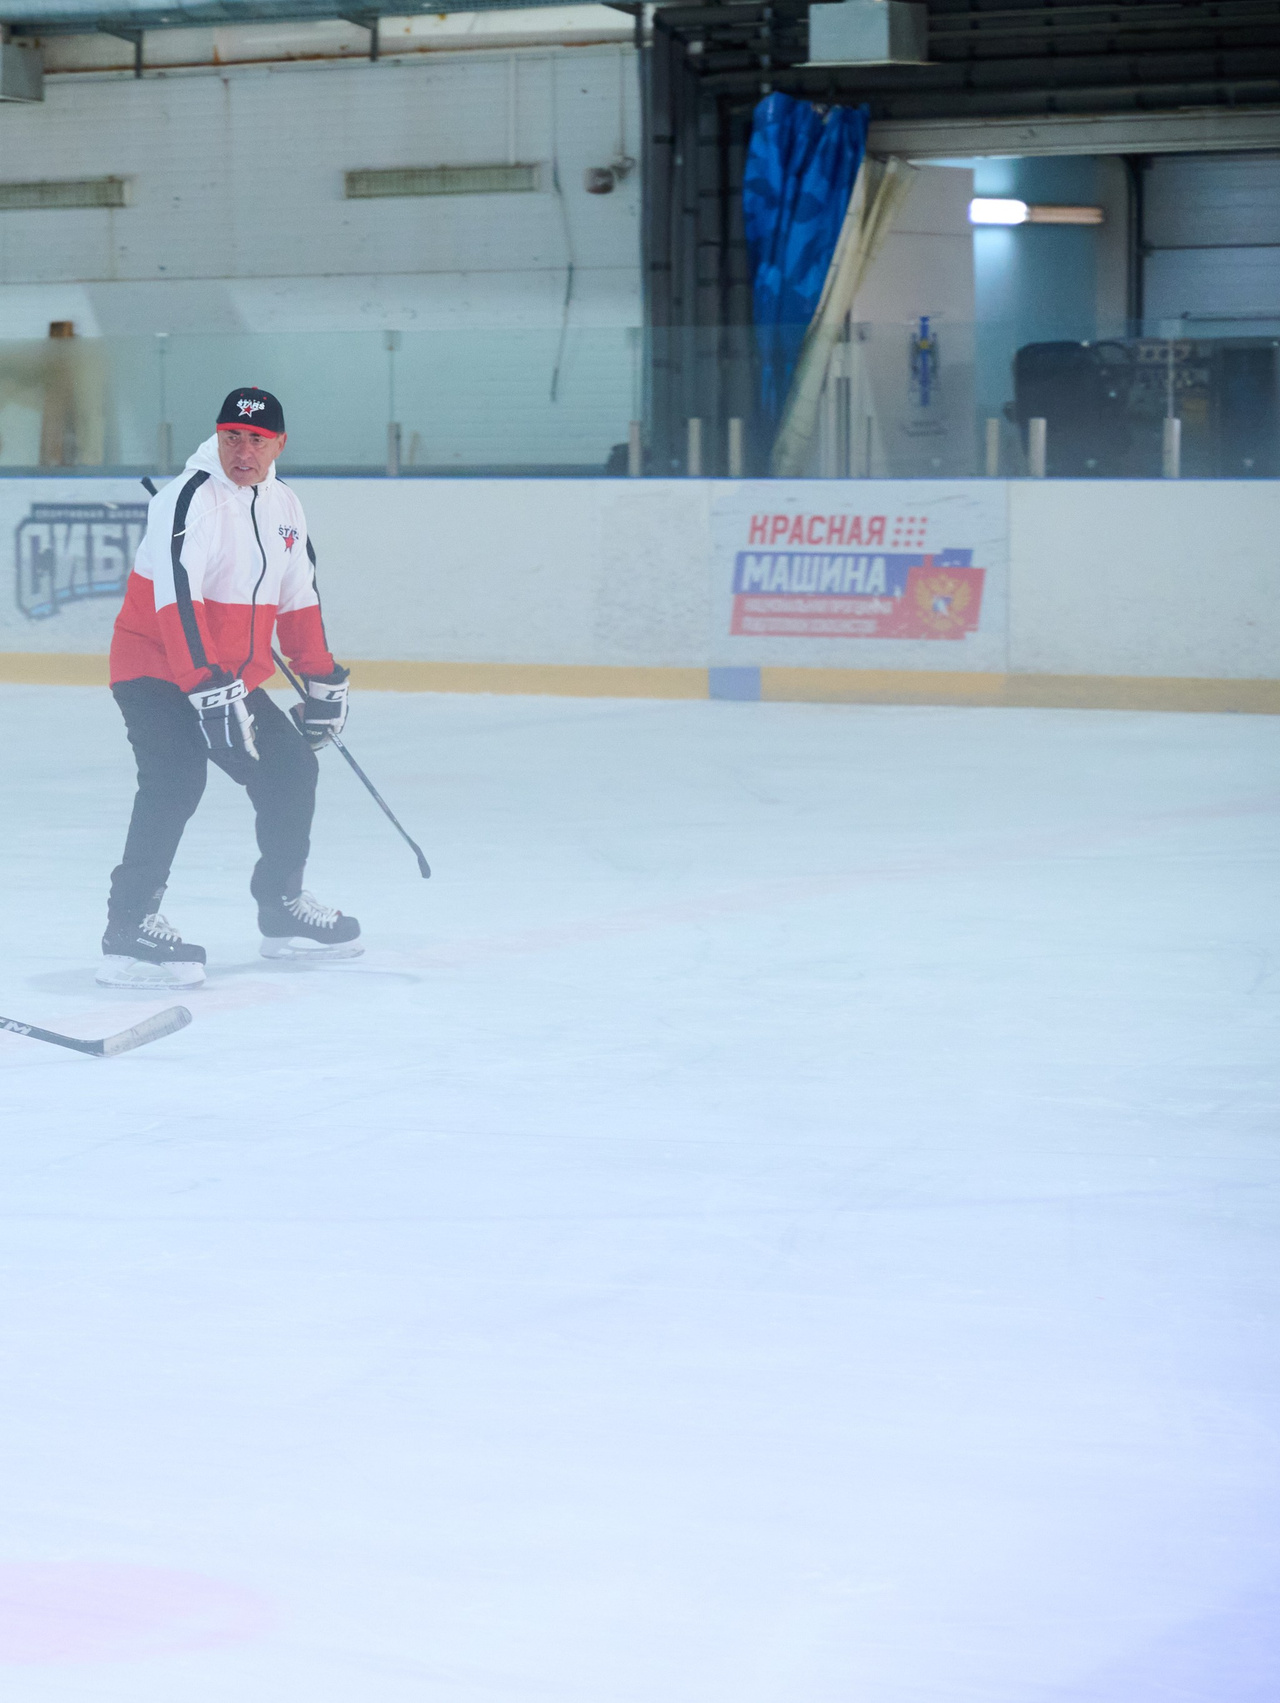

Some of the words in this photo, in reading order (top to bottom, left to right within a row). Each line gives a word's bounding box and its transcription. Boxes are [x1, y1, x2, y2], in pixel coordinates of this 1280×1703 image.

[748, 515, 888, 546] КРАСНАЯ
[741, 554, 887, 593] МАШИНА
[200, 681, 247, 708] CC
